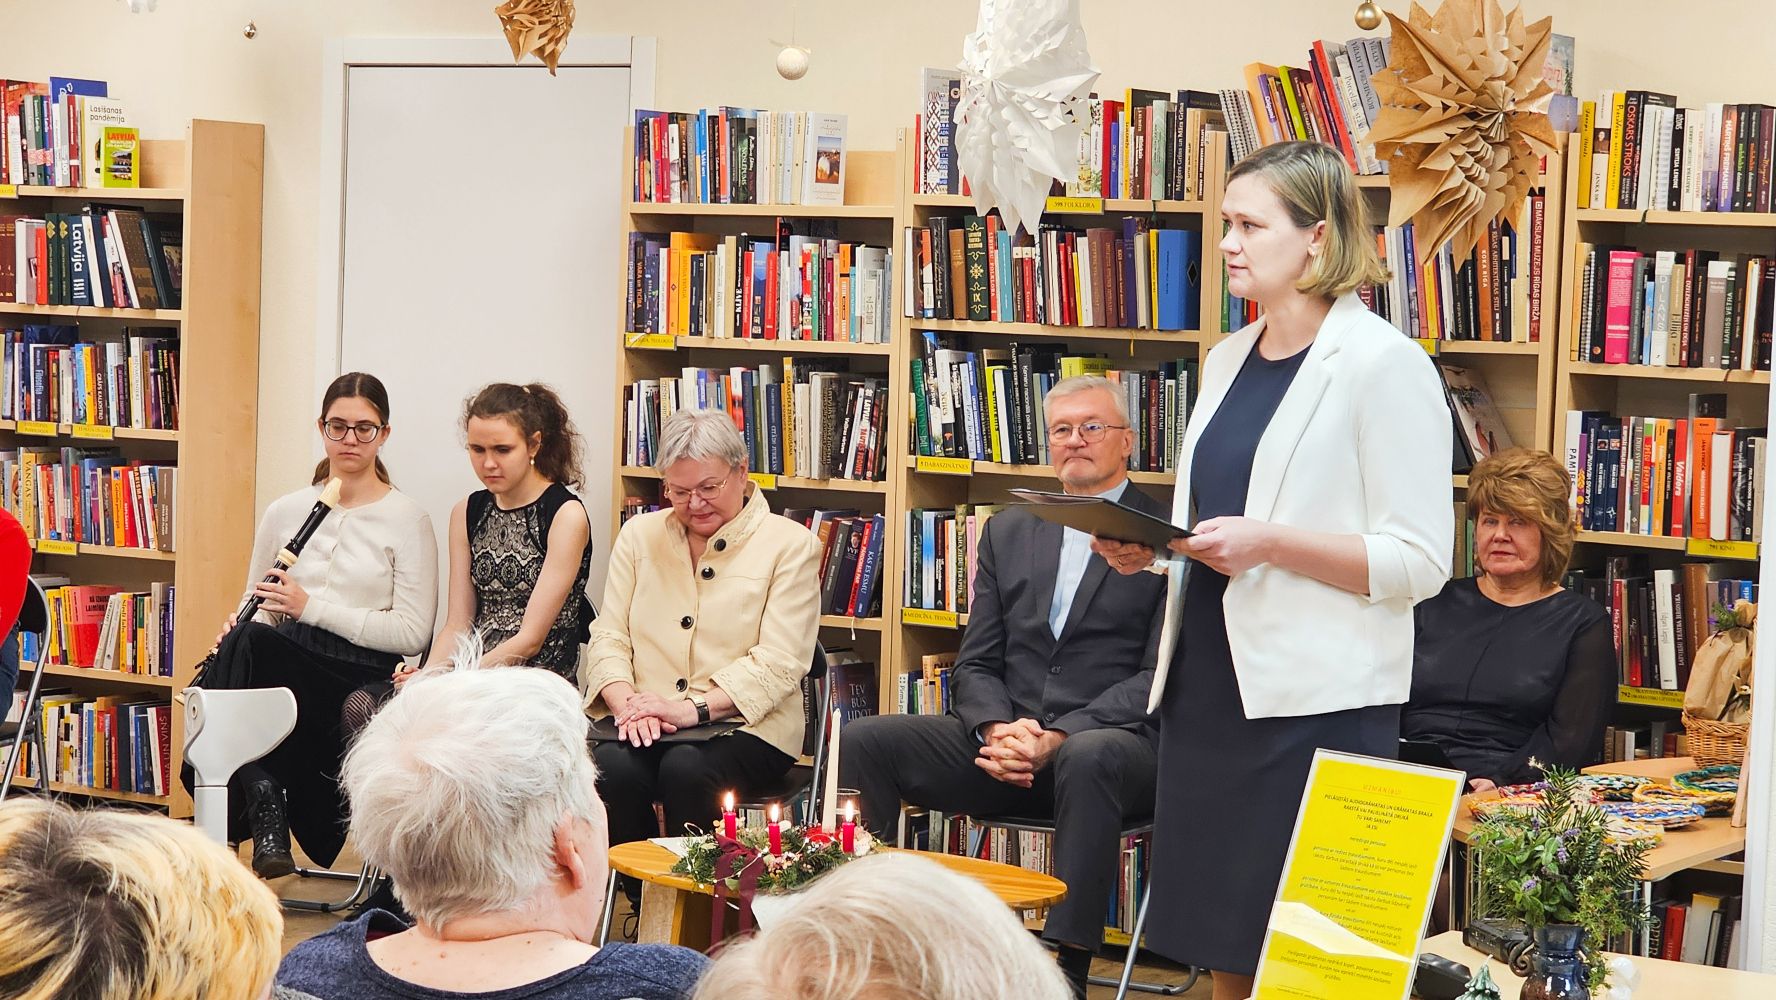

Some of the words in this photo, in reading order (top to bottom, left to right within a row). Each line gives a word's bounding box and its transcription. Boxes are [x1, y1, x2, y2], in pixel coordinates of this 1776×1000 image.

[90, 104, 123, 115] Lasīšanas
[1264, 96, 1275, 119] Origami
[90, 113, 126, 124] pandēmija
[1625, 105, 1636, 140] OSKARS
[106, 132, 136, 141] LATVIJA
[1178, 138, 1183, 147] un
[1622, 142, 1634, 177] STROKS
[1064, 202, 1096, 210] FOLKLORA
[1533, 209, 1543, 245] MĀKSLAS
[71, 223, 85, 272] Latvija
[1533, 245, 1542, 275] MUZEJS
[1532, 276, 1541, 298] RĪGAS
[973, 293, 981, 302] IX
[1531, 299, 1541, 321] BIRŽA
[1723, 317, 1732, 344] MARISS
[35, 369, 44, 395] Filosofija
[96, 372, 104, 391] GRĀFS
[1024, 414, 1032, 431] parka
[854, 452, 864, 476] FRONTE
[866, 550, 875, 564] KAS
[865, 564, 873, 573] ES
[860, 573, 871, 594] ESMU
[849, 683, 865, 695] TEV
[162, 743, 170, 761] UN
[1393, 806, 1417, 815] GRĀMATAS
